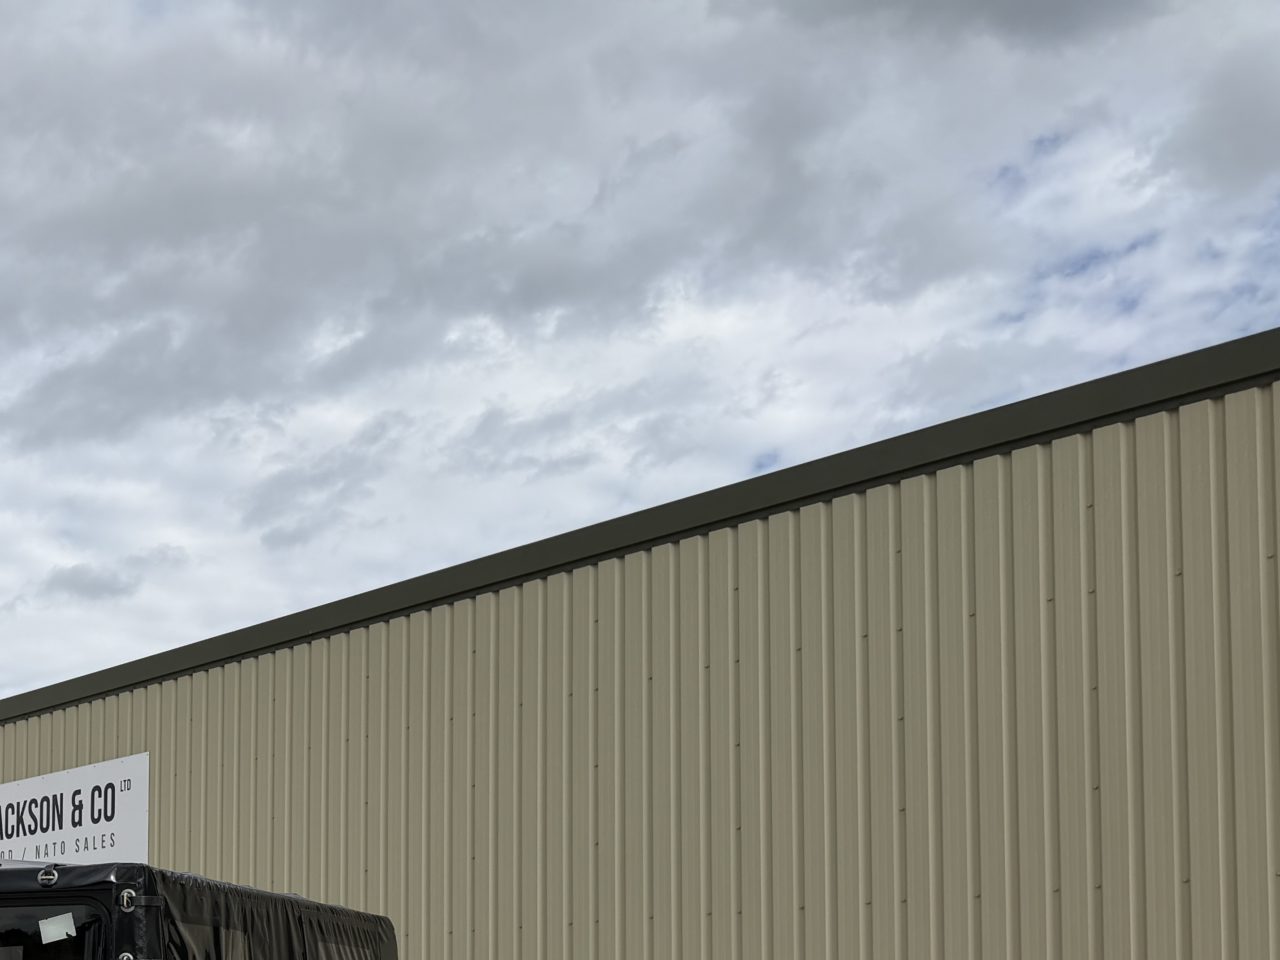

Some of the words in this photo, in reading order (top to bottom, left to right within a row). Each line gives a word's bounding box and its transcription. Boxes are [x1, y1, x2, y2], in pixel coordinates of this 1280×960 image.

[71, 789, 83, 829] &
[90, 782, 116, 825] CO
[120, 779, 132, 792] LTD
[35, 841, 66, 860] NATO
[75, 832, 116, 853] SALES
